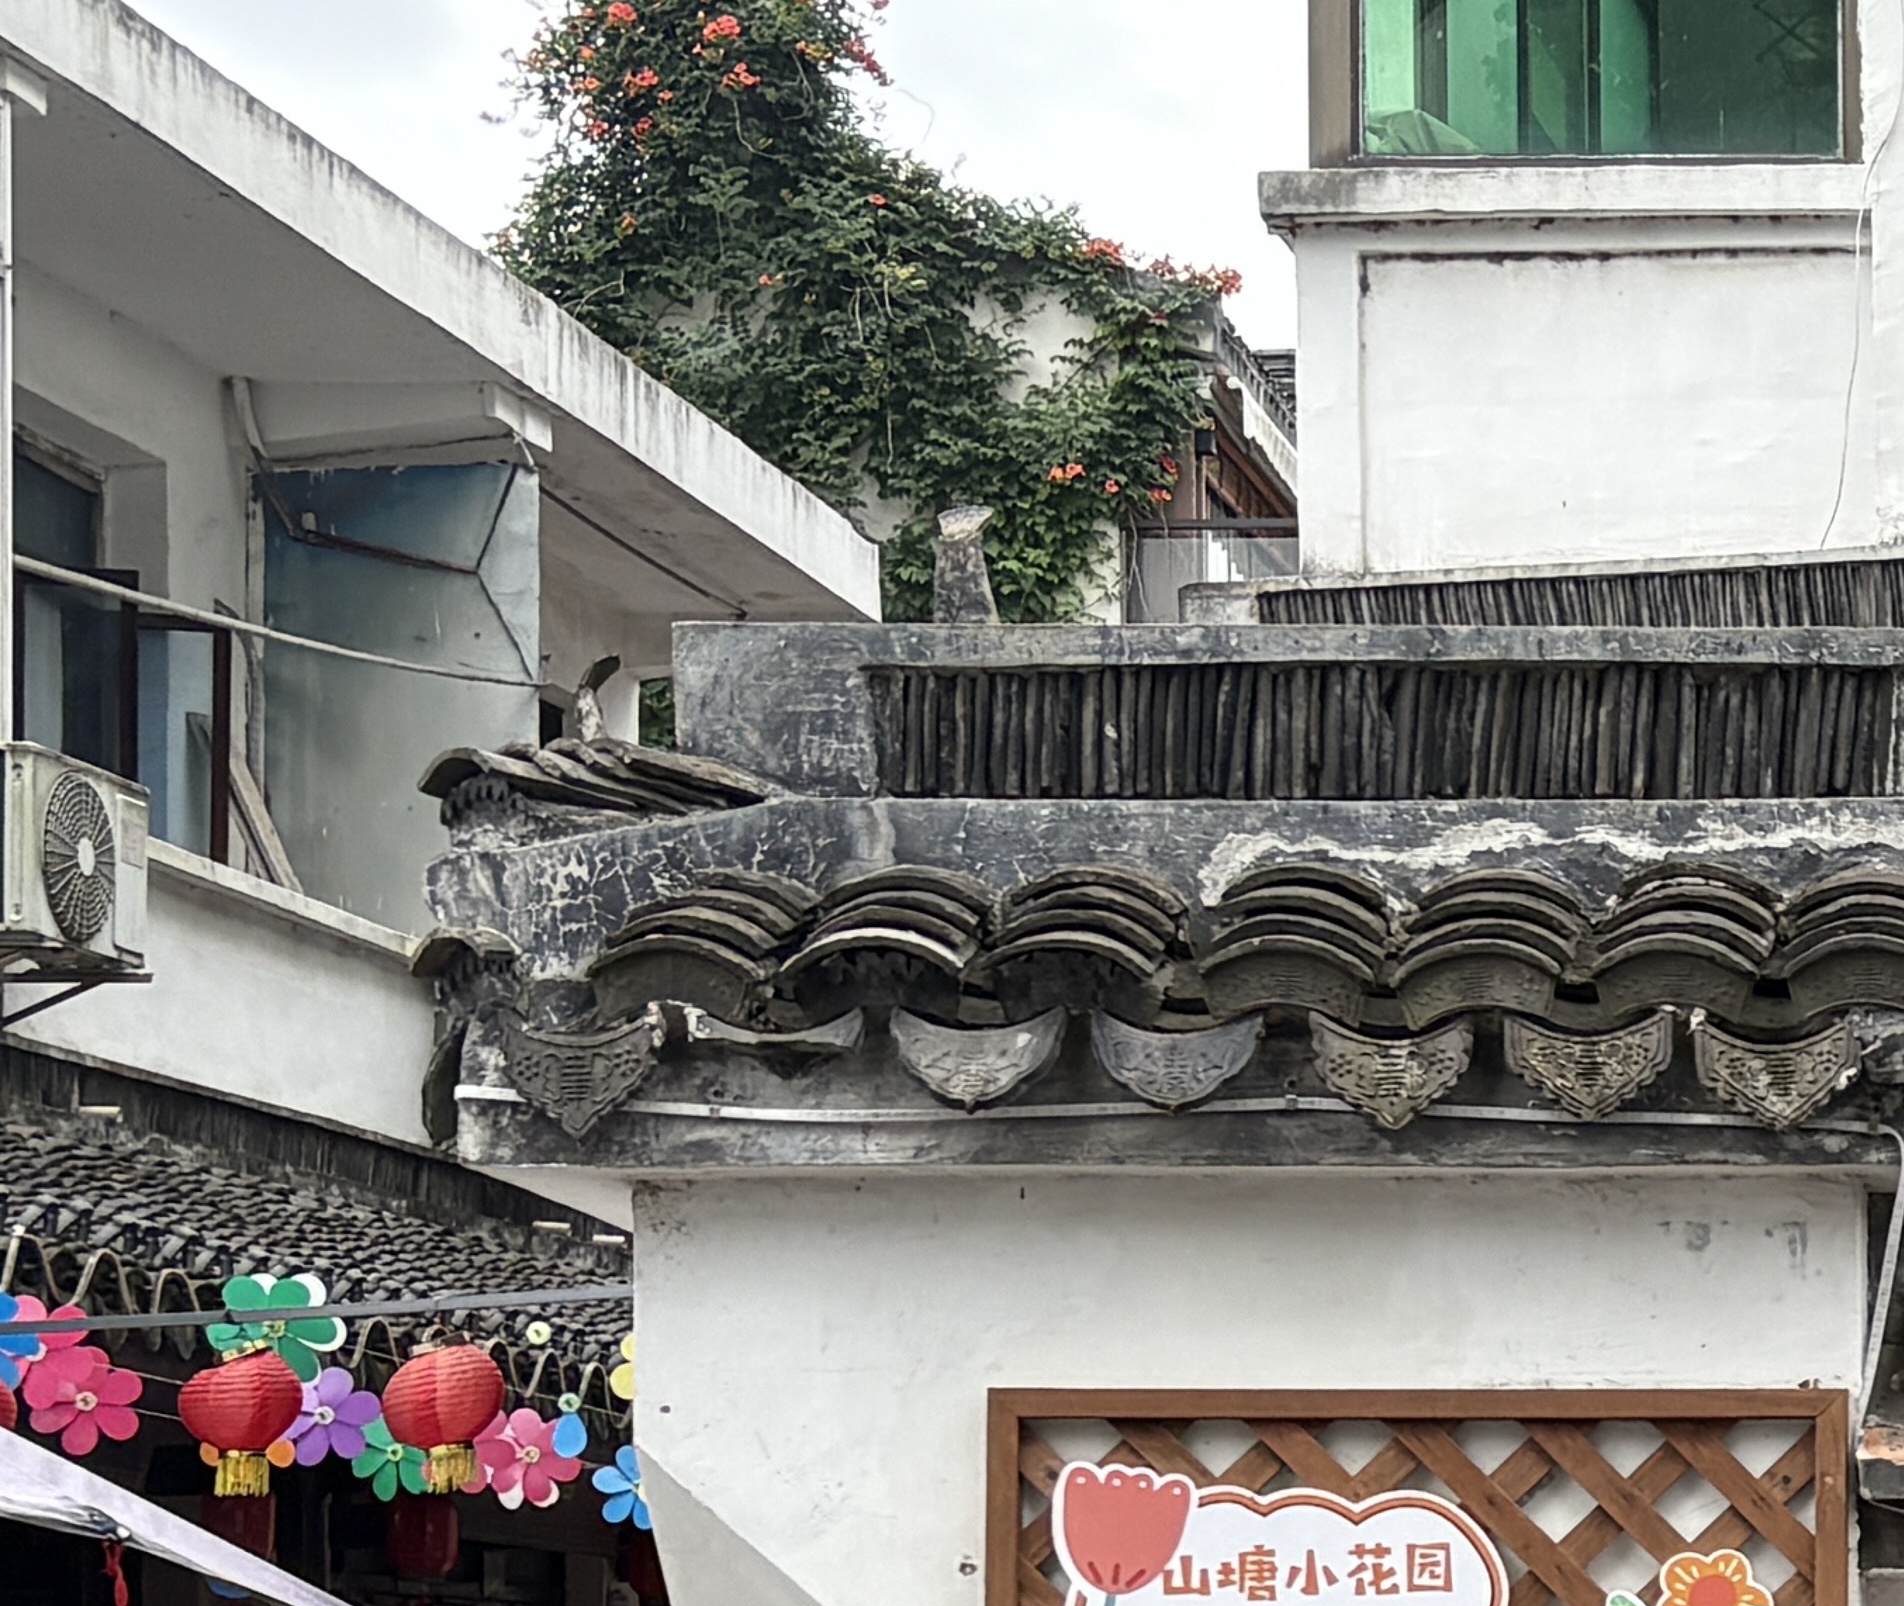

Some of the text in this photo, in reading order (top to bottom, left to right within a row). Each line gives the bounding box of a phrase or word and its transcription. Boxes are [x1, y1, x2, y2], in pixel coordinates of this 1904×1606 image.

[1162, 1543, 1455, 1602] 山塘小花园
